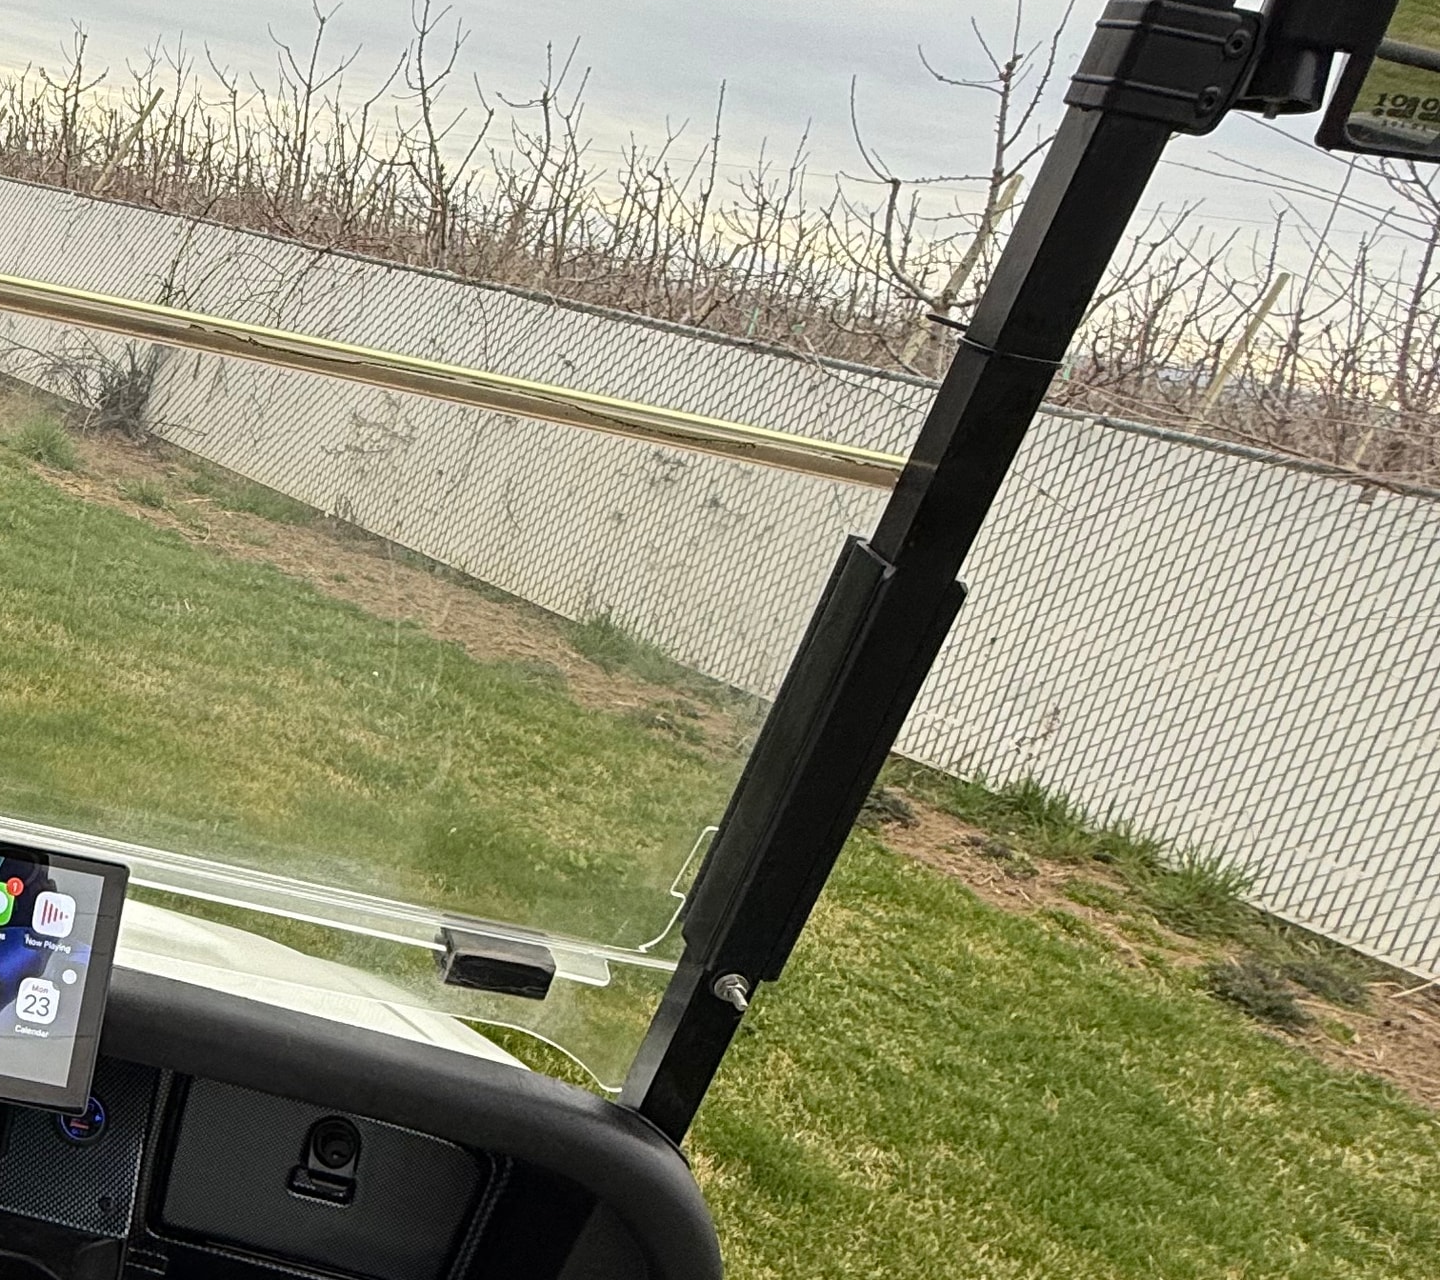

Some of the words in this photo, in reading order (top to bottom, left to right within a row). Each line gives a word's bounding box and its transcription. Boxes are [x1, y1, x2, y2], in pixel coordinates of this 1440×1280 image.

[25, 937, 43, 948] Now
[43, 941, 72, 954] Playing
[31, 984, 49, 994] Mon
[22, 994, 51, 1017] 23
[14, 1024, 50, 1038] Calendar
